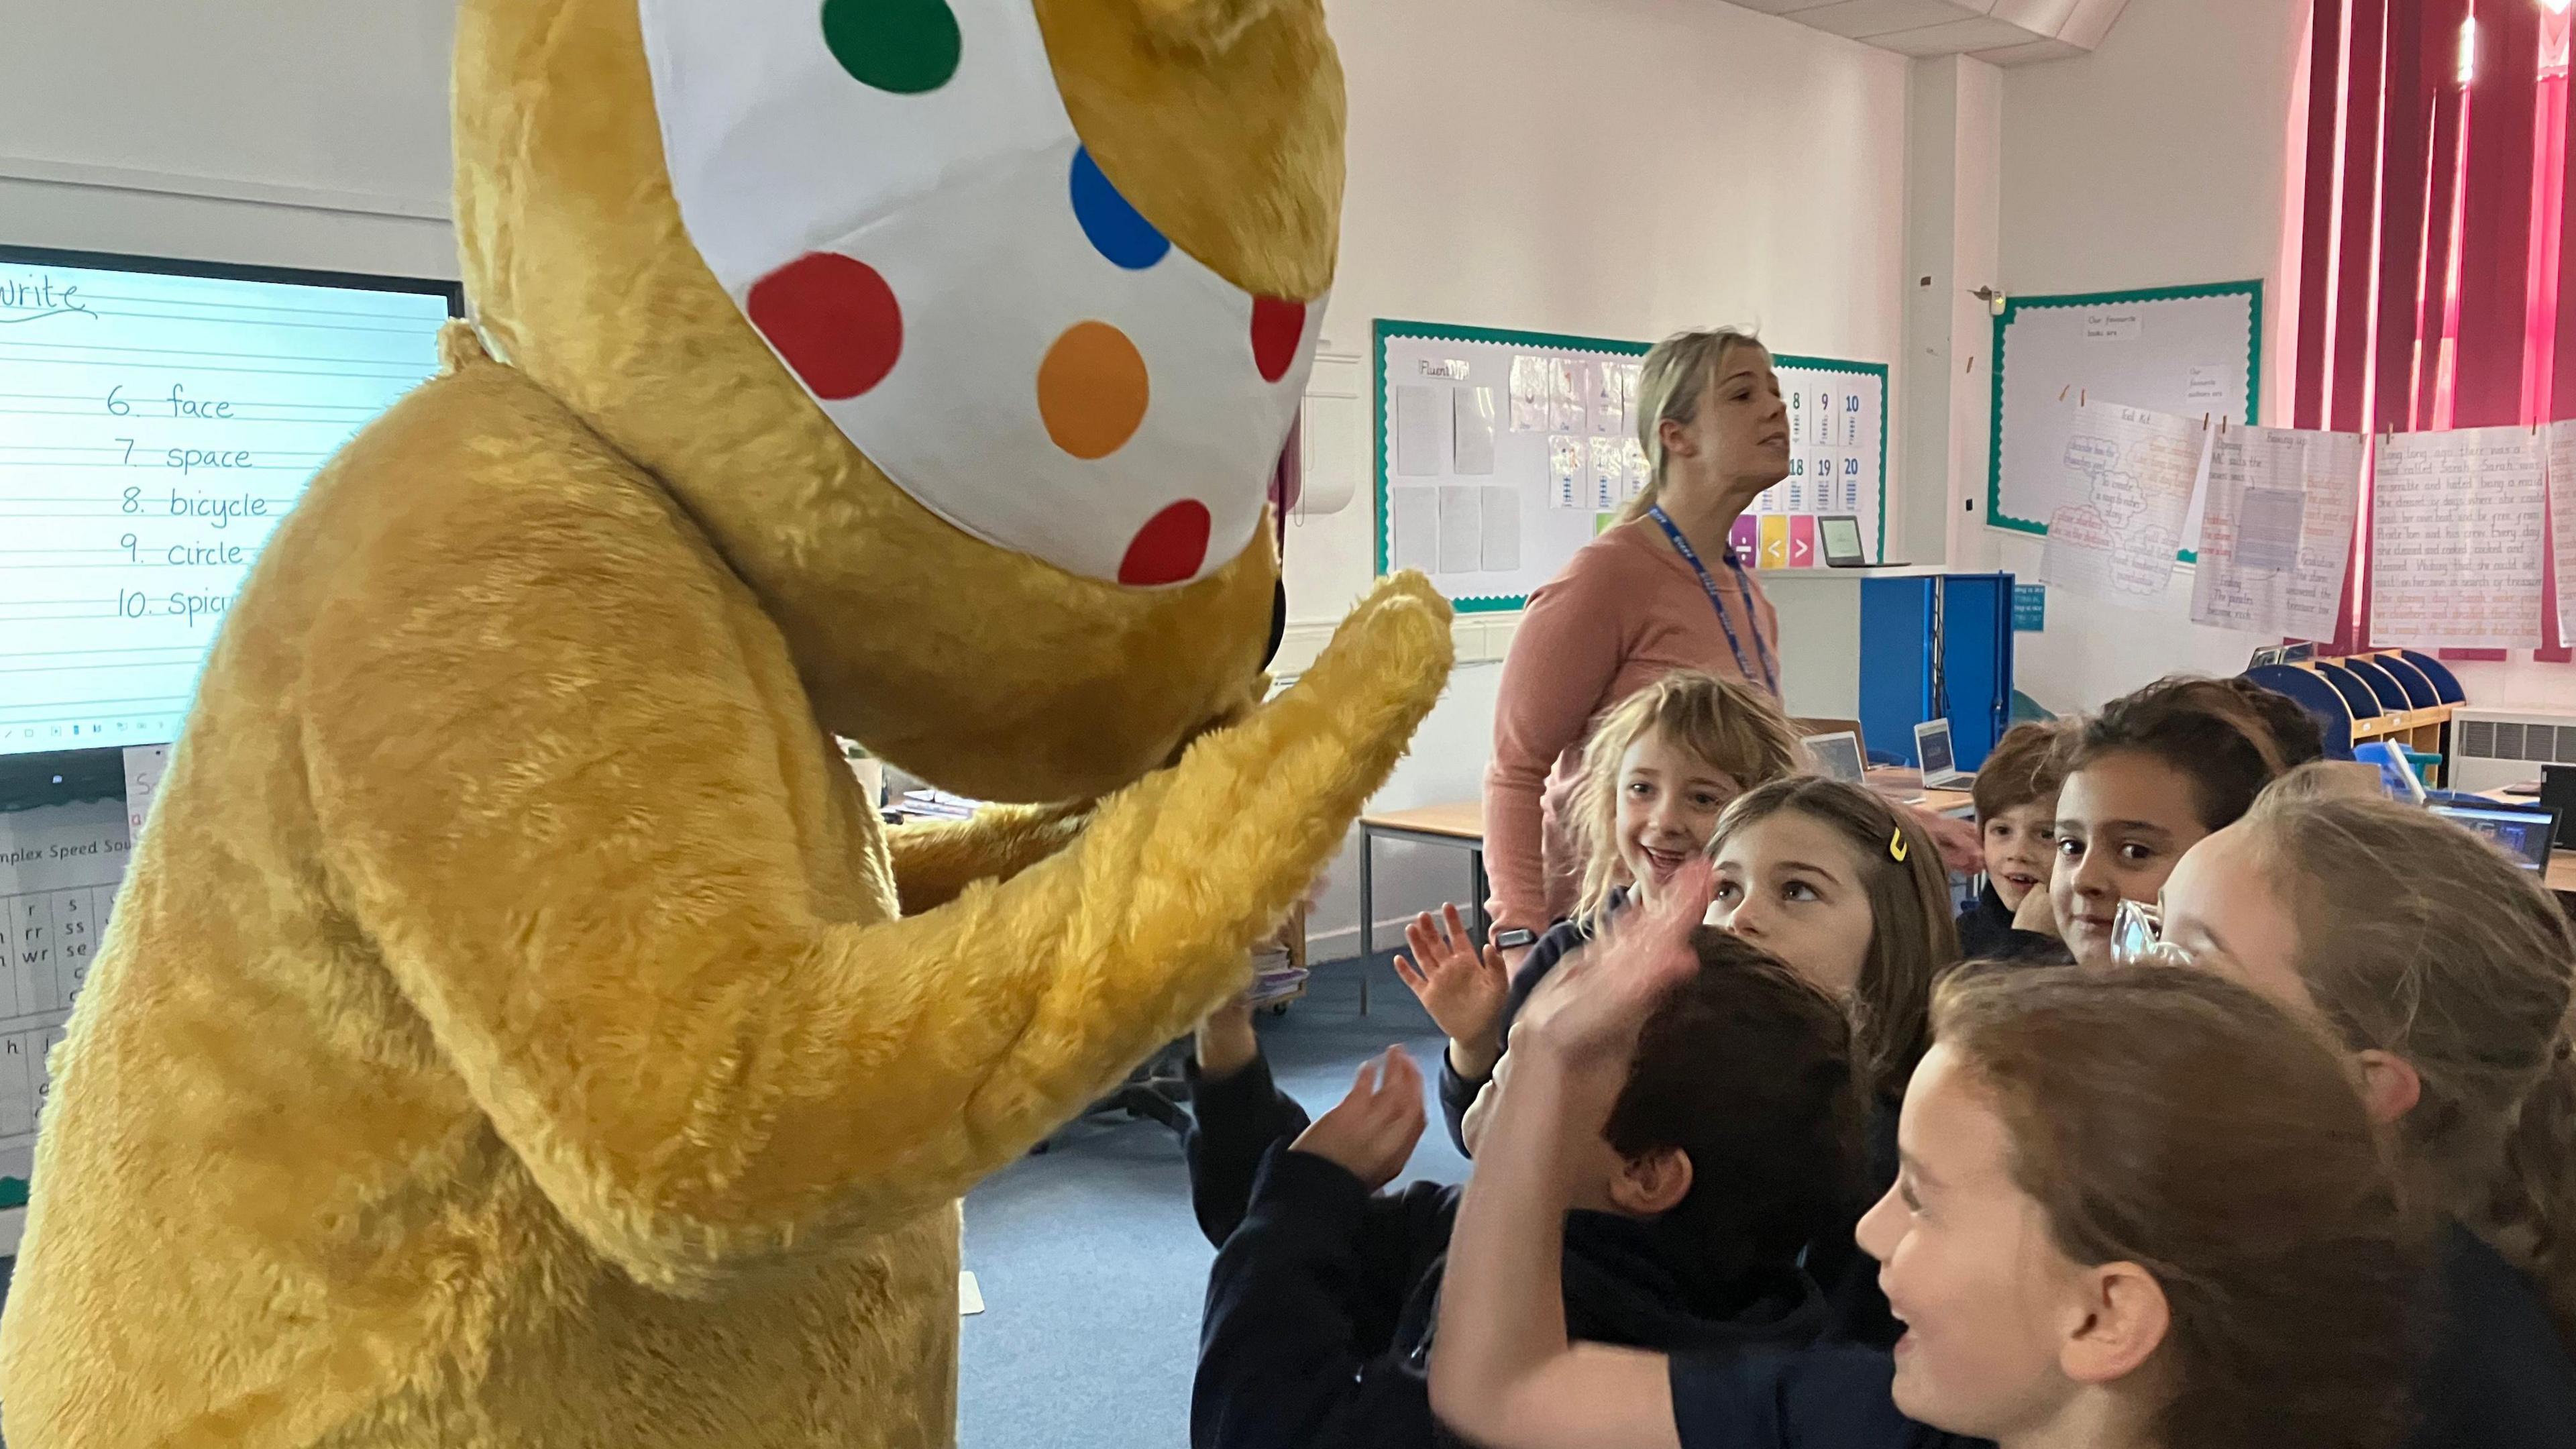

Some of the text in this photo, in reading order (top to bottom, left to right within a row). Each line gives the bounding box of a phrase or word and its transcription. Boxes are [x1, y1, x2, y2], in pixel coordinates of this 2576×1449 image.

[107, 383, 234, 419] 6. face
[1792, 392, 1859, 413] 8 9 10
[166, 447, 253, 476] space
[2407, 445, 2426, 463] long
[1789, 458, 1858, 476] 18 19 20
[2404, 462, 2432, 474] called
[2481, 459, 2513, 472] Sarah
[2424, 478, 2441, 490] and
[122, 486, 268, 529] 8. bicycle
[120, 533, 244, 566] 9. circle
[119, 588, 152, 619] 10.
[50, 841, 98, 861] Speed
[29, 899, 78, 916] r s
[25, 922, 85, 941] rr ss
[22, 949, 49, 963] wr
[66, 943, 87, 957] se
[7, 1039, 18, 1055] h
